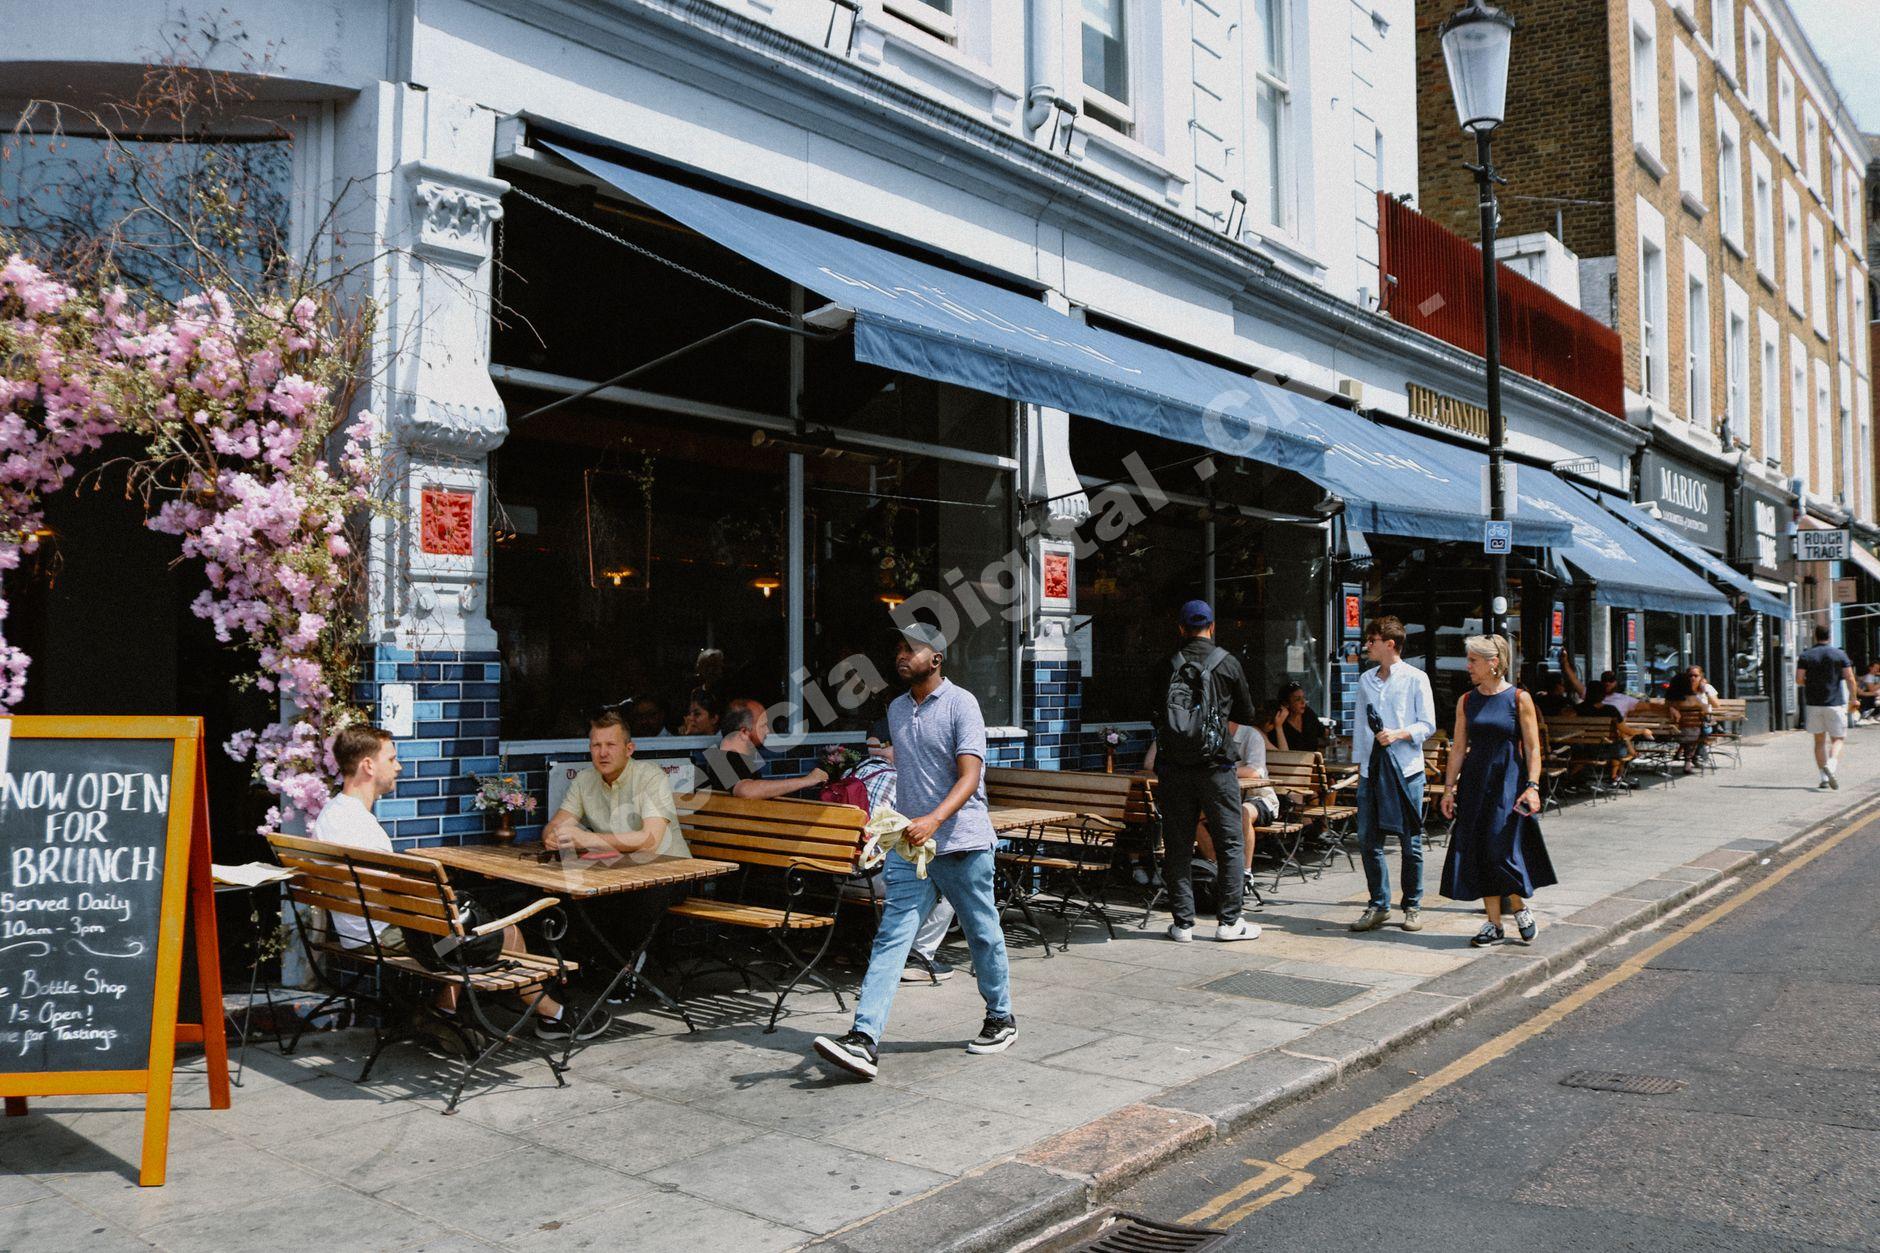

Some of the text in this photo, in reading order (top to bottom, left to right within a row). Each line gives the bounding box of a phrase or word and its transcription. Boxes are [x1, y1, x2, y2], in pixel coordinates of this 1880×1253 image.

[1405, 381, 1508, 444] THE GINSTITE
[1660, 467, 1708, 515] MARIOS
[1804, 532, 1843, 545] ROUGH
[1805, 546, 1843, 558] TRADE
[2, 771, 168, 813] NOW OPEN
[46, 811, 108, 843] FOR
[12, 846, 156, 887] BRUNCH
[0, 892, 130, 921] Served Daily
[2, 920, 53, 938] 10am
[70, 917, 105, 936] 3pm
[21, 969, 127, 999] Bottle Shop
[19, 1029, 48, 1056] for
[53, 1025, 118, 1050] Tastings
